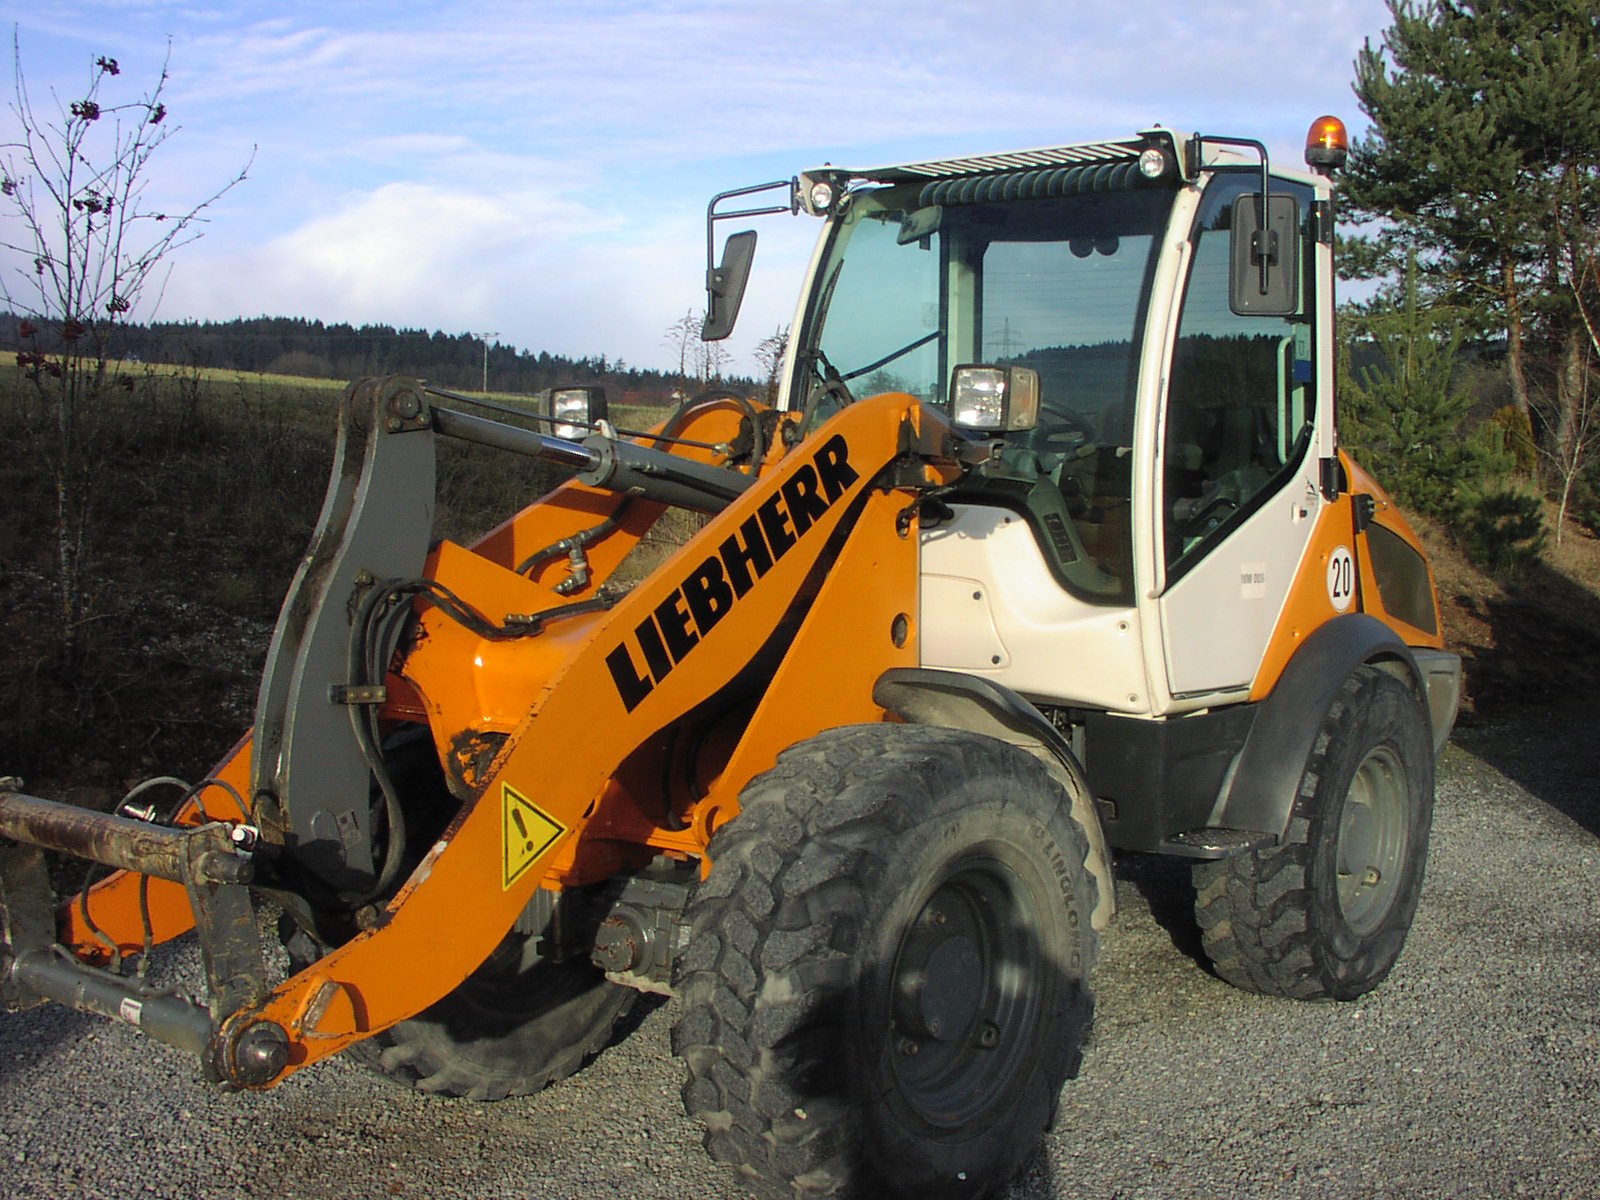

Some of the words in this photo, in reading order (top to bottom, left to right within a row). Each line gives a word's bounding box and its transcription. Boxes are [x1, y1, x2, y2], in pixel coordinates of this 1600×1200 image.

[605, 434, 860, 714] LIEBHERR
[1333, 556, 1351, 598] 20
[1043, 840, 1082, 968] LINGLONG
